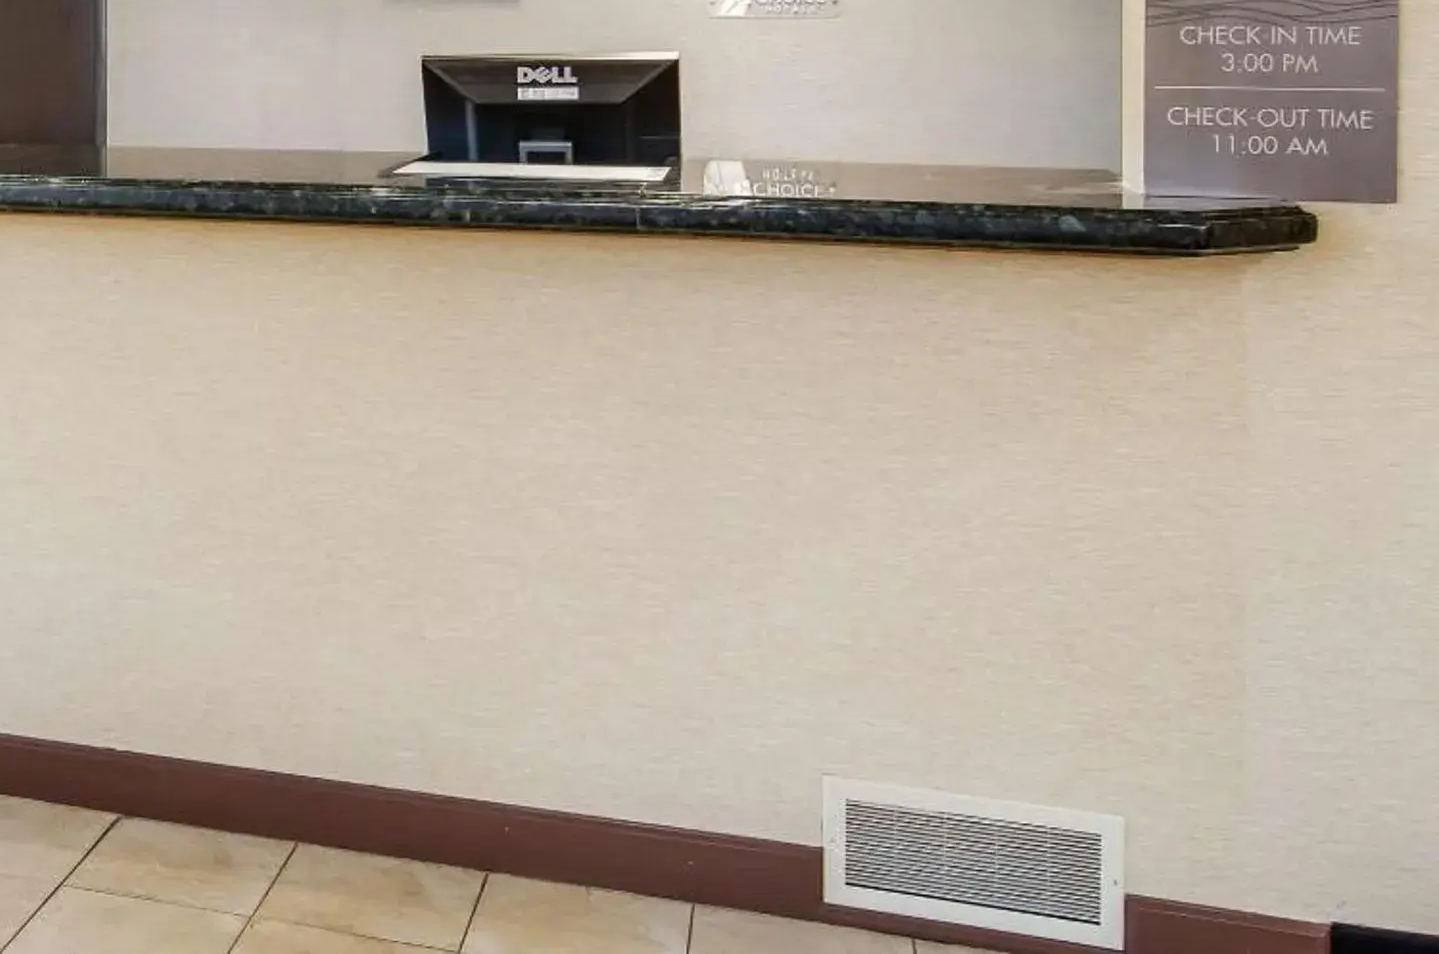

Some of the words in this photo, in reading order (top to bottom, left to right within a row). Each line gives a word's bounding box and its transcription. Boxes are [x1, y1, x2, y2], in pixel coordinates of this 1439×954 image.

[1306, 26, 1362, 45] TIME
[1220, 52, 1274, 73] 3:00
[1282, 53, 1319, 73] PM
[517, 66, 578, 83] DELL
[1317, 109, 1375, 130] TIME
[1213, 134, 1279, 155] 11:00
[1284, 137, 1329, 156] AM
